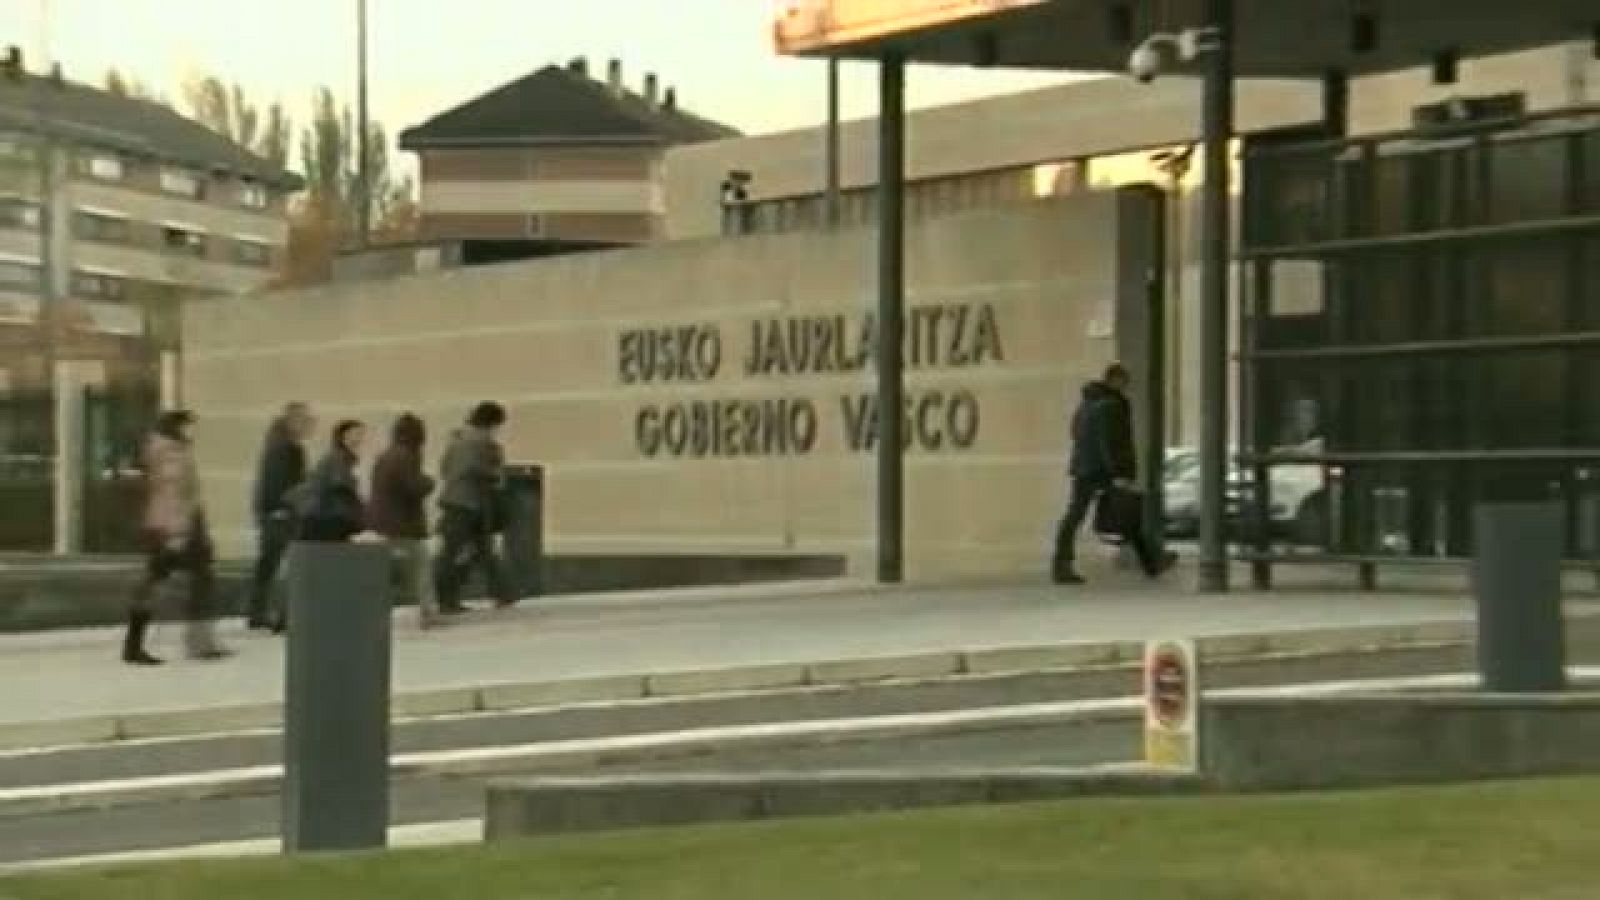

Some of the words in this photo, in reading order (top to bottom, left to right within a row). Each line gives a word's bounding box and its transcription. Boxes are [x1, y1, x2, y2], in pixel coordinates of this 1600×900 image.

[618, 325, 722, 384] EUSKO
[745, 303, 1004, 375] JAURLAITZA
[635, 398, 818, 458] GOBIERNO
